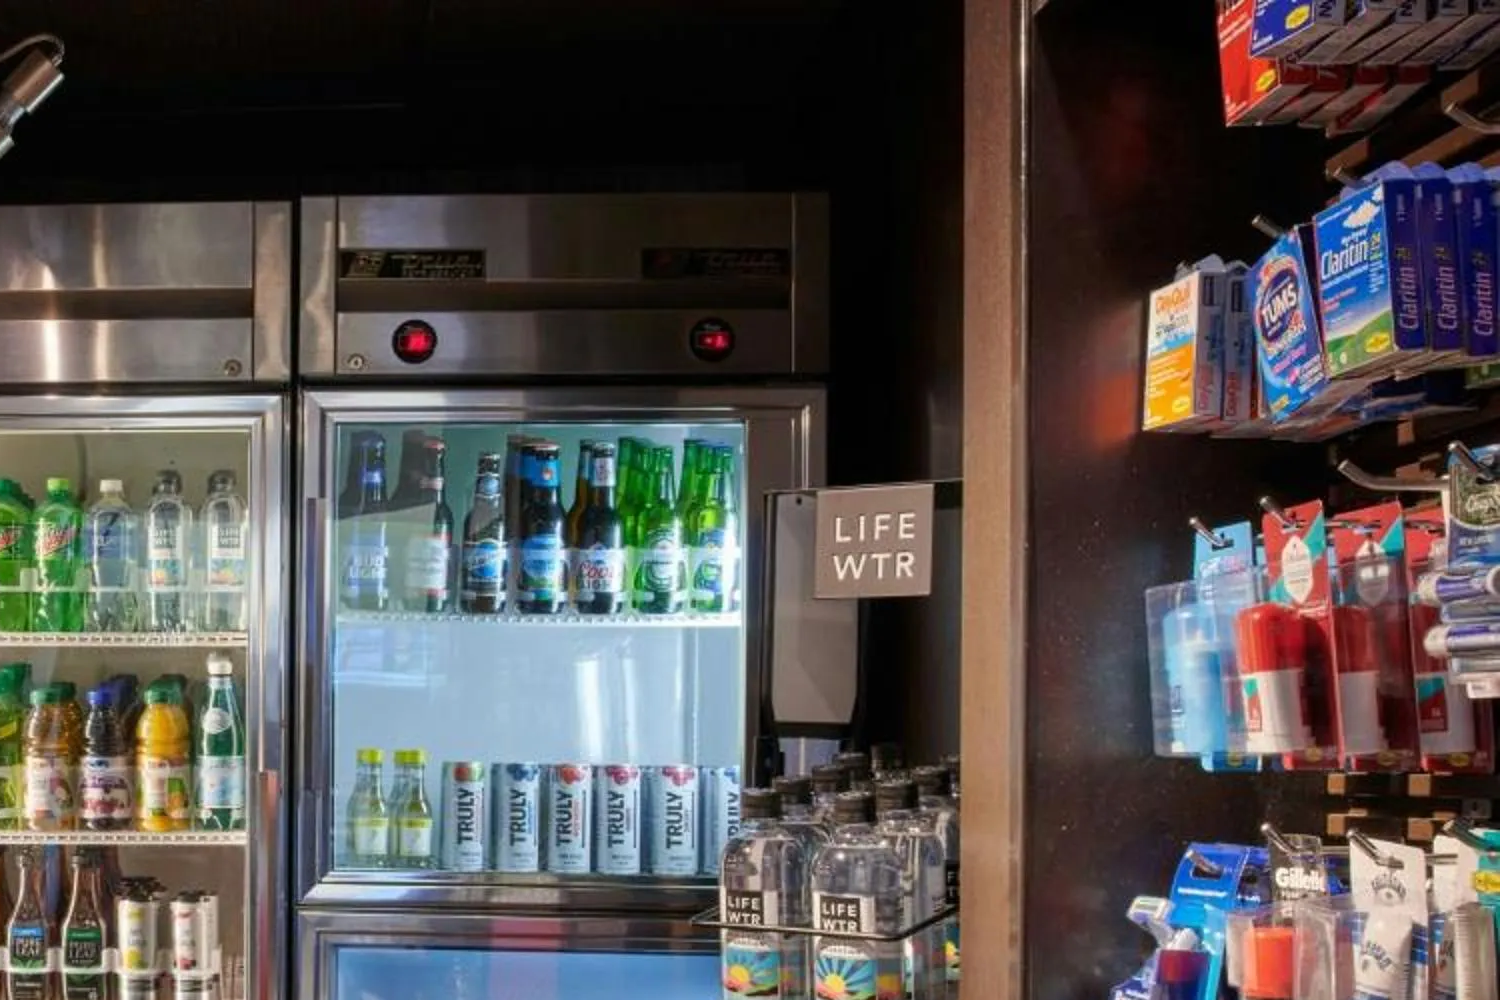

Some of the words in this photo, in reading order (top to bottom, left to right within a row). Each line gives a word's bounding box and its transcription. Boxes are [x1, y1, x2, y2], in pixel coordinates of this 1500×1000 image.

[1322, 240, 1368, 282] Claritin
[1262, 282, 1297, 329] TUMS
[835, 513, 916, 543] LIFE
[833, 551, 915, 581] WTR
[457, 787, 474, 845] TRULY
[510, 788, 527, 846] TRULY
[556, 789, 573, 847] TRULY
[607, 790, 625, 849] TRULY
[666, 791, 683, 849] TRULY
[727, 791, 740, 838] RULY
[727, 896, 761, 911] LIFE
[728, 911, 761, 926] WTR
[822, 902, 857, 917] LIFE
[822, 919, 858, 932] WTR
